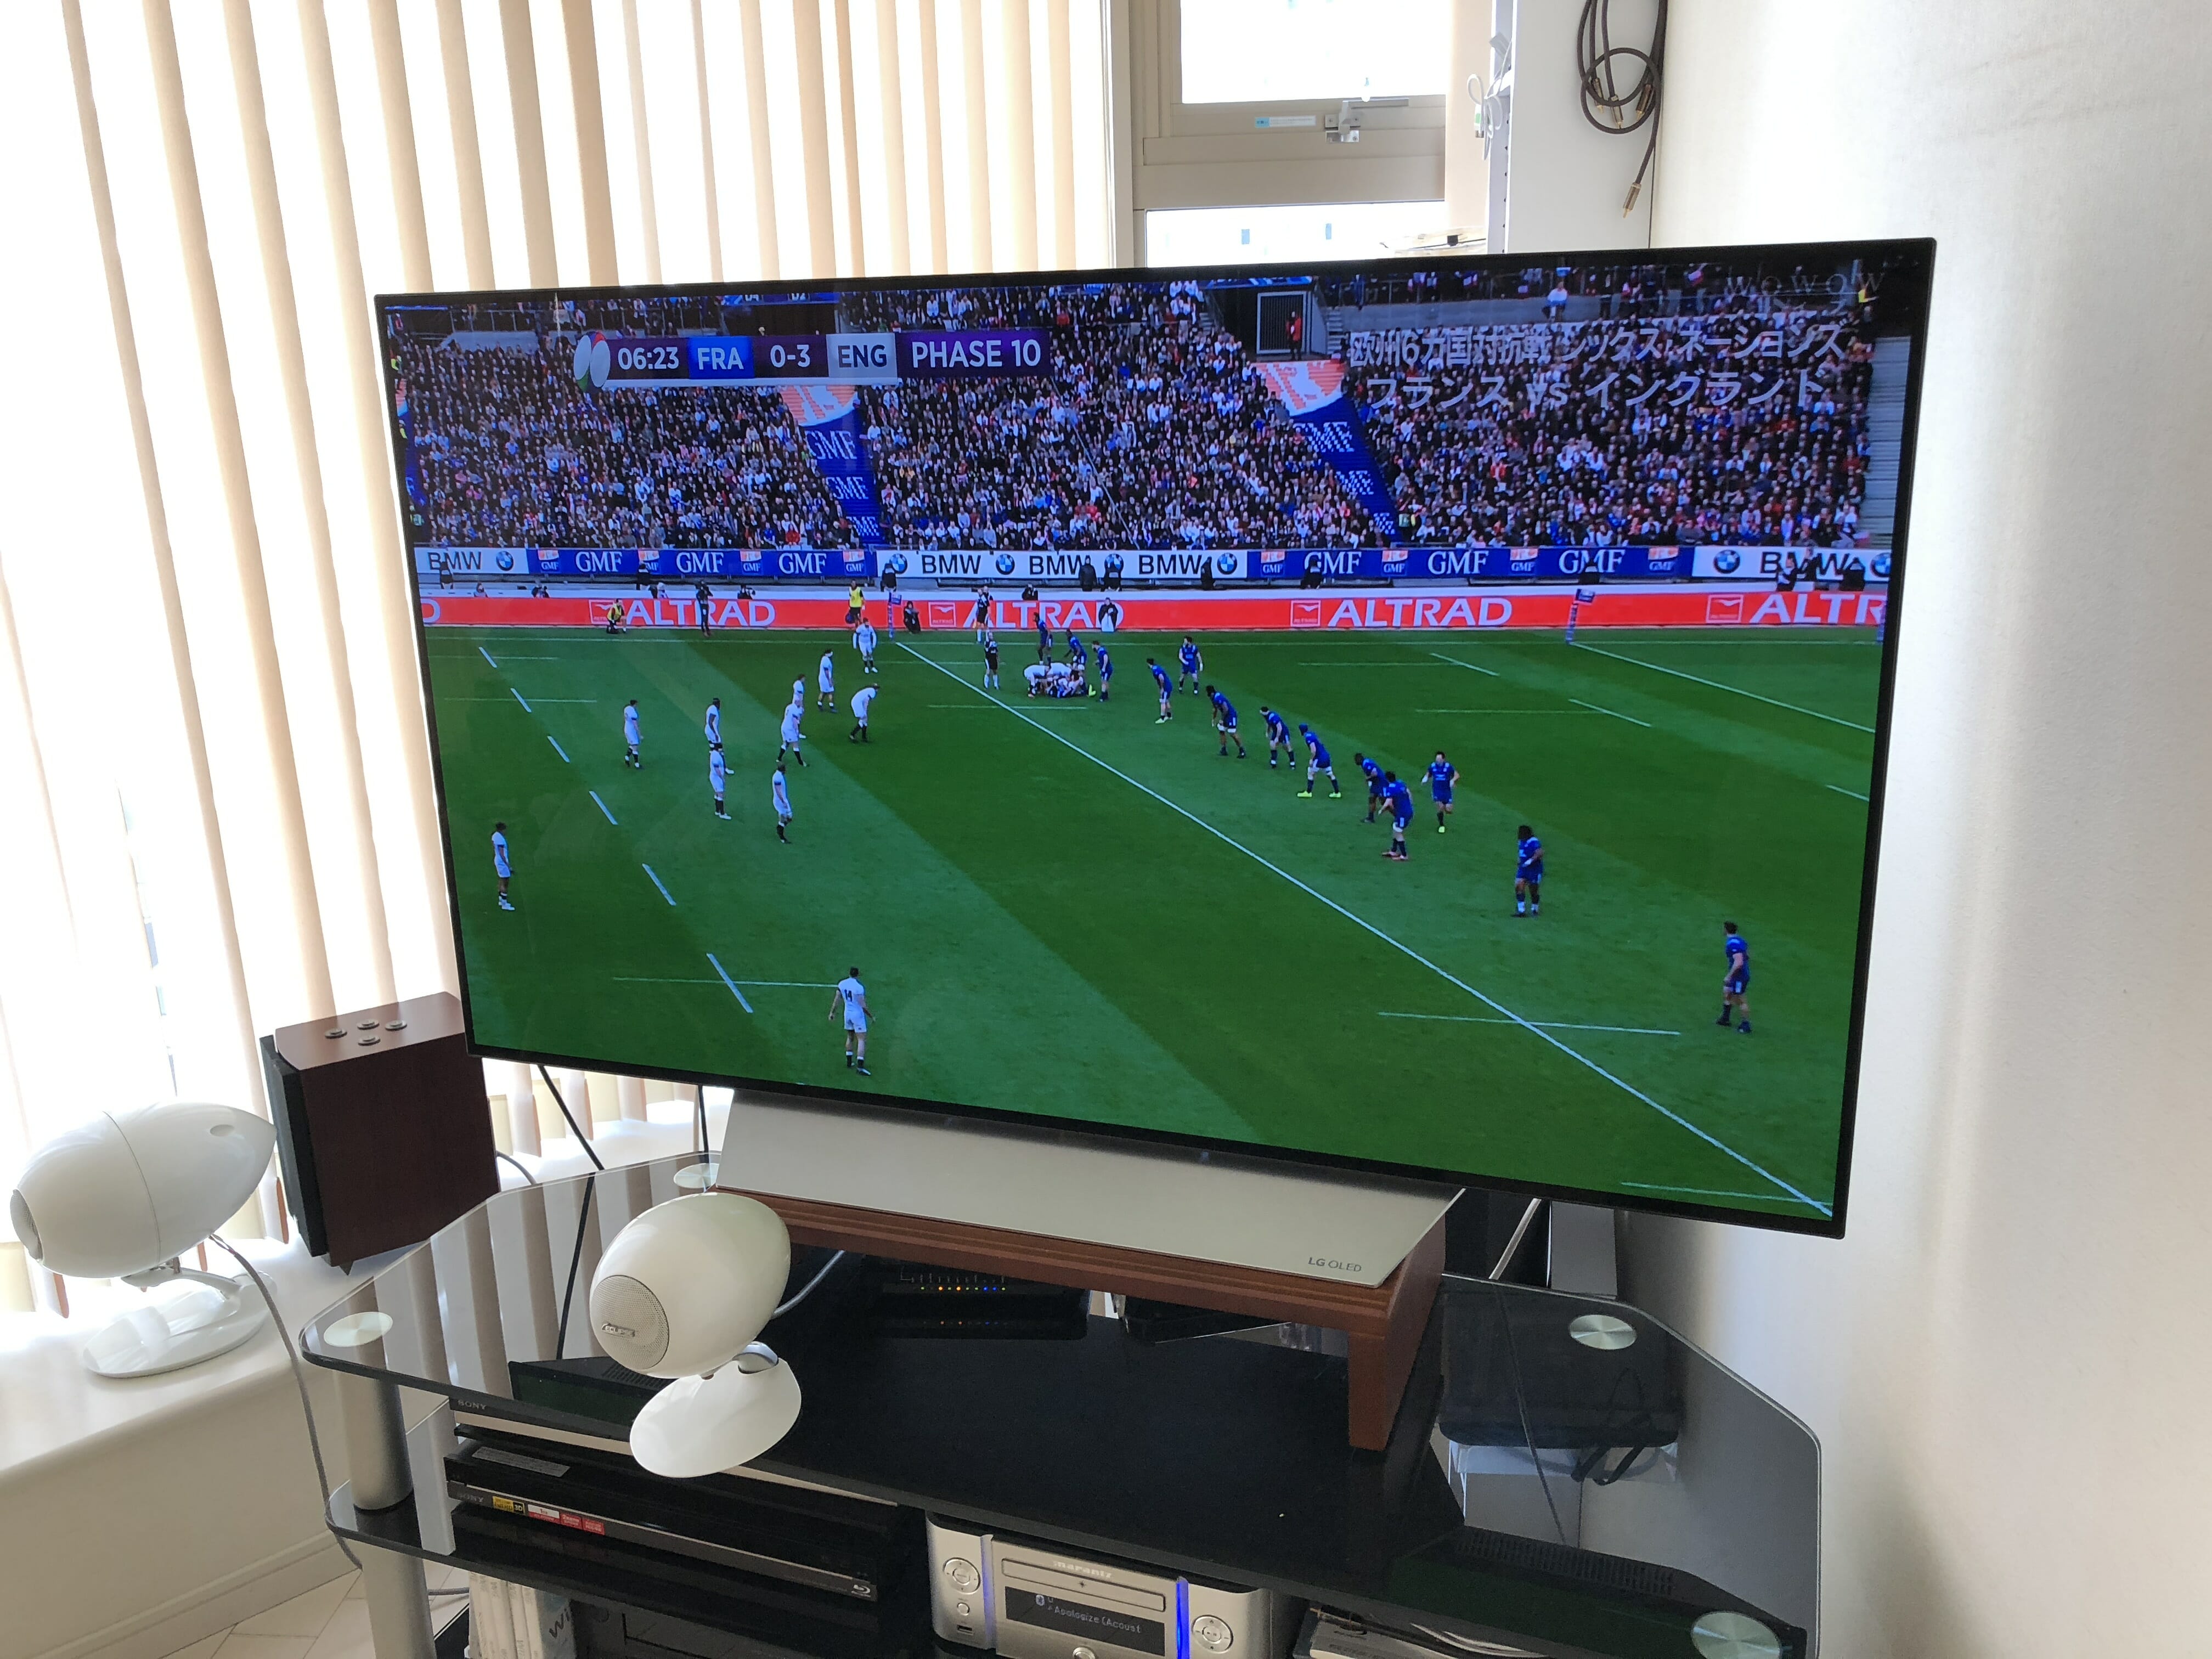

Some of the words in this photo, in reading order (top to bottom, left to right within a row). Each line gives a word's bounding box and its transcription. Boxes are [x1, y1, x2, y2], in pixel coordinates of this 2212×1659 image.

[618, 347, 679, 370] 06:23
[697, 347, 744, 370] FRA
[770, 344, 811, 368] 0-3
[837, 345, 888, 368] ENG
[912, 340, 1003, 368] PHASE
[1011, 338, 1041, 367] 10
[1367, 376, 1512, 410] フランス
[1585, 367, 1826, 409] イングランド
[427, 551, 482, 570] BMW
[541, 561, 559, 571] GMF
[575, 551, 623, 572] GMF
[676, 552, 724, 573] GMF
[743, 562, 761, 572] GMF
[778, 552, 827, 574] GMF
[845, 563, 864, 572] GMF
[922, 554, 981, 574] BMW
[1029, 555, 1083, 575] BMW
[1139, 555, 1202, 574] BMW
[1262, 563, 1283, 574] GMF
[1304, 552, 1362, 574] GMF
[1383, 563, 1406, 573] GMF
[1427, 551, 1489, 574] GMF
[1511, 561, 1535, 572] GMF
[1559, 549, 1626, 574] GMF
[1649, 561, 1675, 571] GMF
[627, 600, 776, 627] ALTRAD
[1328, 597, 1513, 627] ALTRAD
[1748, 594, 1887, 624] ALTR
[844, 989, 853, 1003] 14
[1308, 1257, 1325, 1267] LG
[1328, 1260, 1362, 1272] OLED
[605, 1325, 634, 1337] ECLIP
[458, 1400, 487, 1410] SONY
[457, 1492, 484, 1503] ONY
[1057, 1561, 1112, 1578] marantz
[1054, 1606, 1099, 1623] Apologize
[1102, 1616, 1142, 1634] (Acoust
